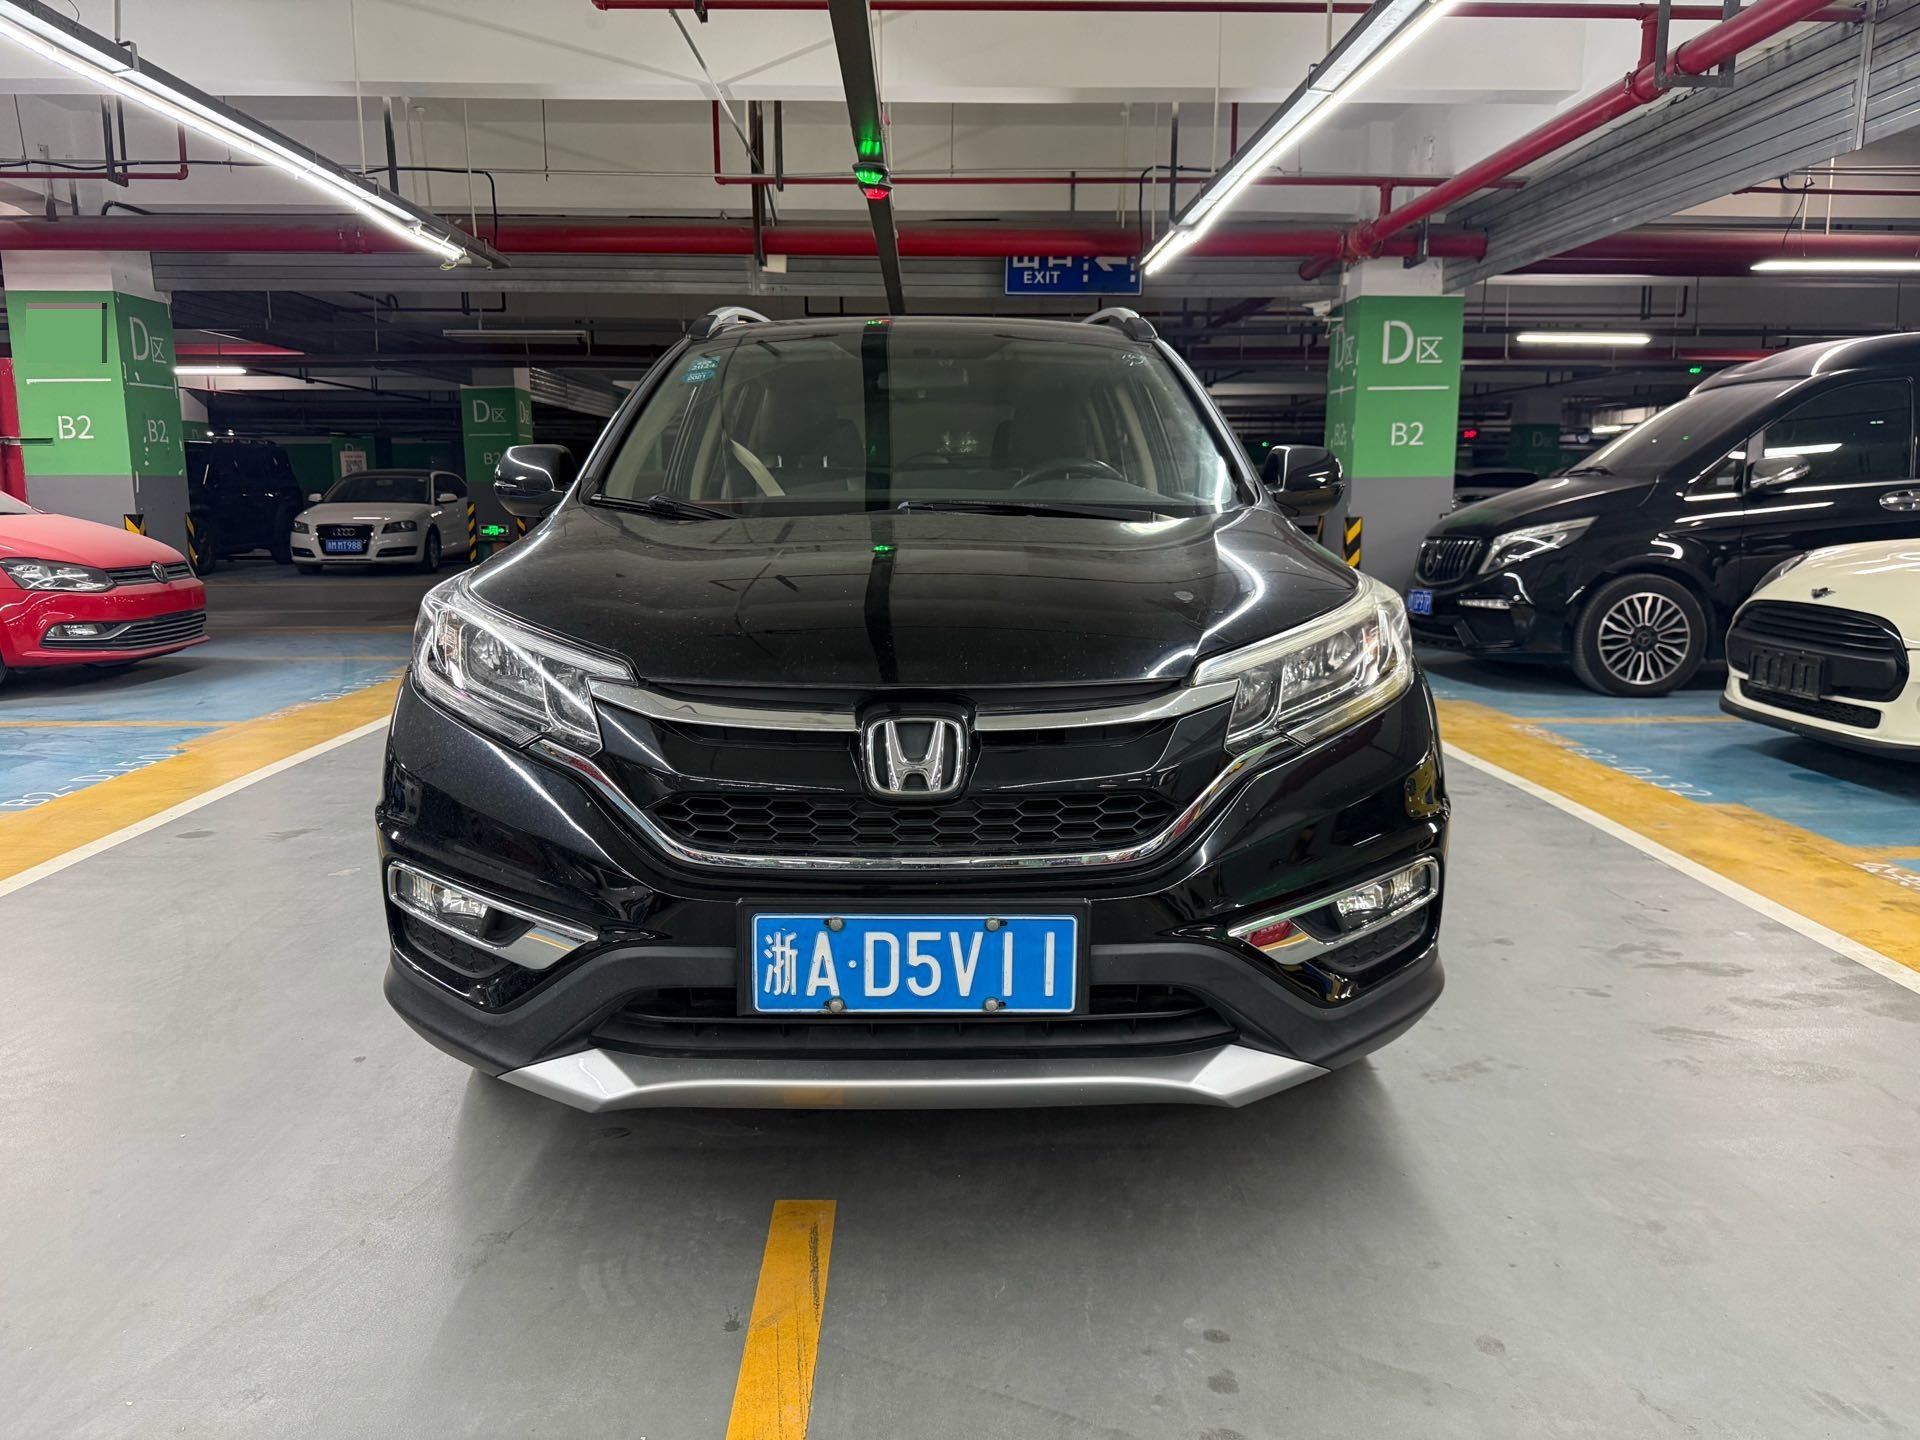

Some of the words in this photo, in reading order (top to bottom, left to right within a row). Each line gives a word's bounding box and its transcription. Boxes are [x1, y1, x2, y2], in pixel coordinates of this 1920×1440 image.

[1023, 271, 1061, 284] EXIT
[129, 316, 168, 364] D区
[1382, 320, 1444, 365] D区
[472, 399, 508, 423] D区
[57, 415, 95, 439] B2
[147, 419, 169, 443] B2
[1391, 422, 1425, 446] B2
[0, 753, 177, 806] B2-D150
